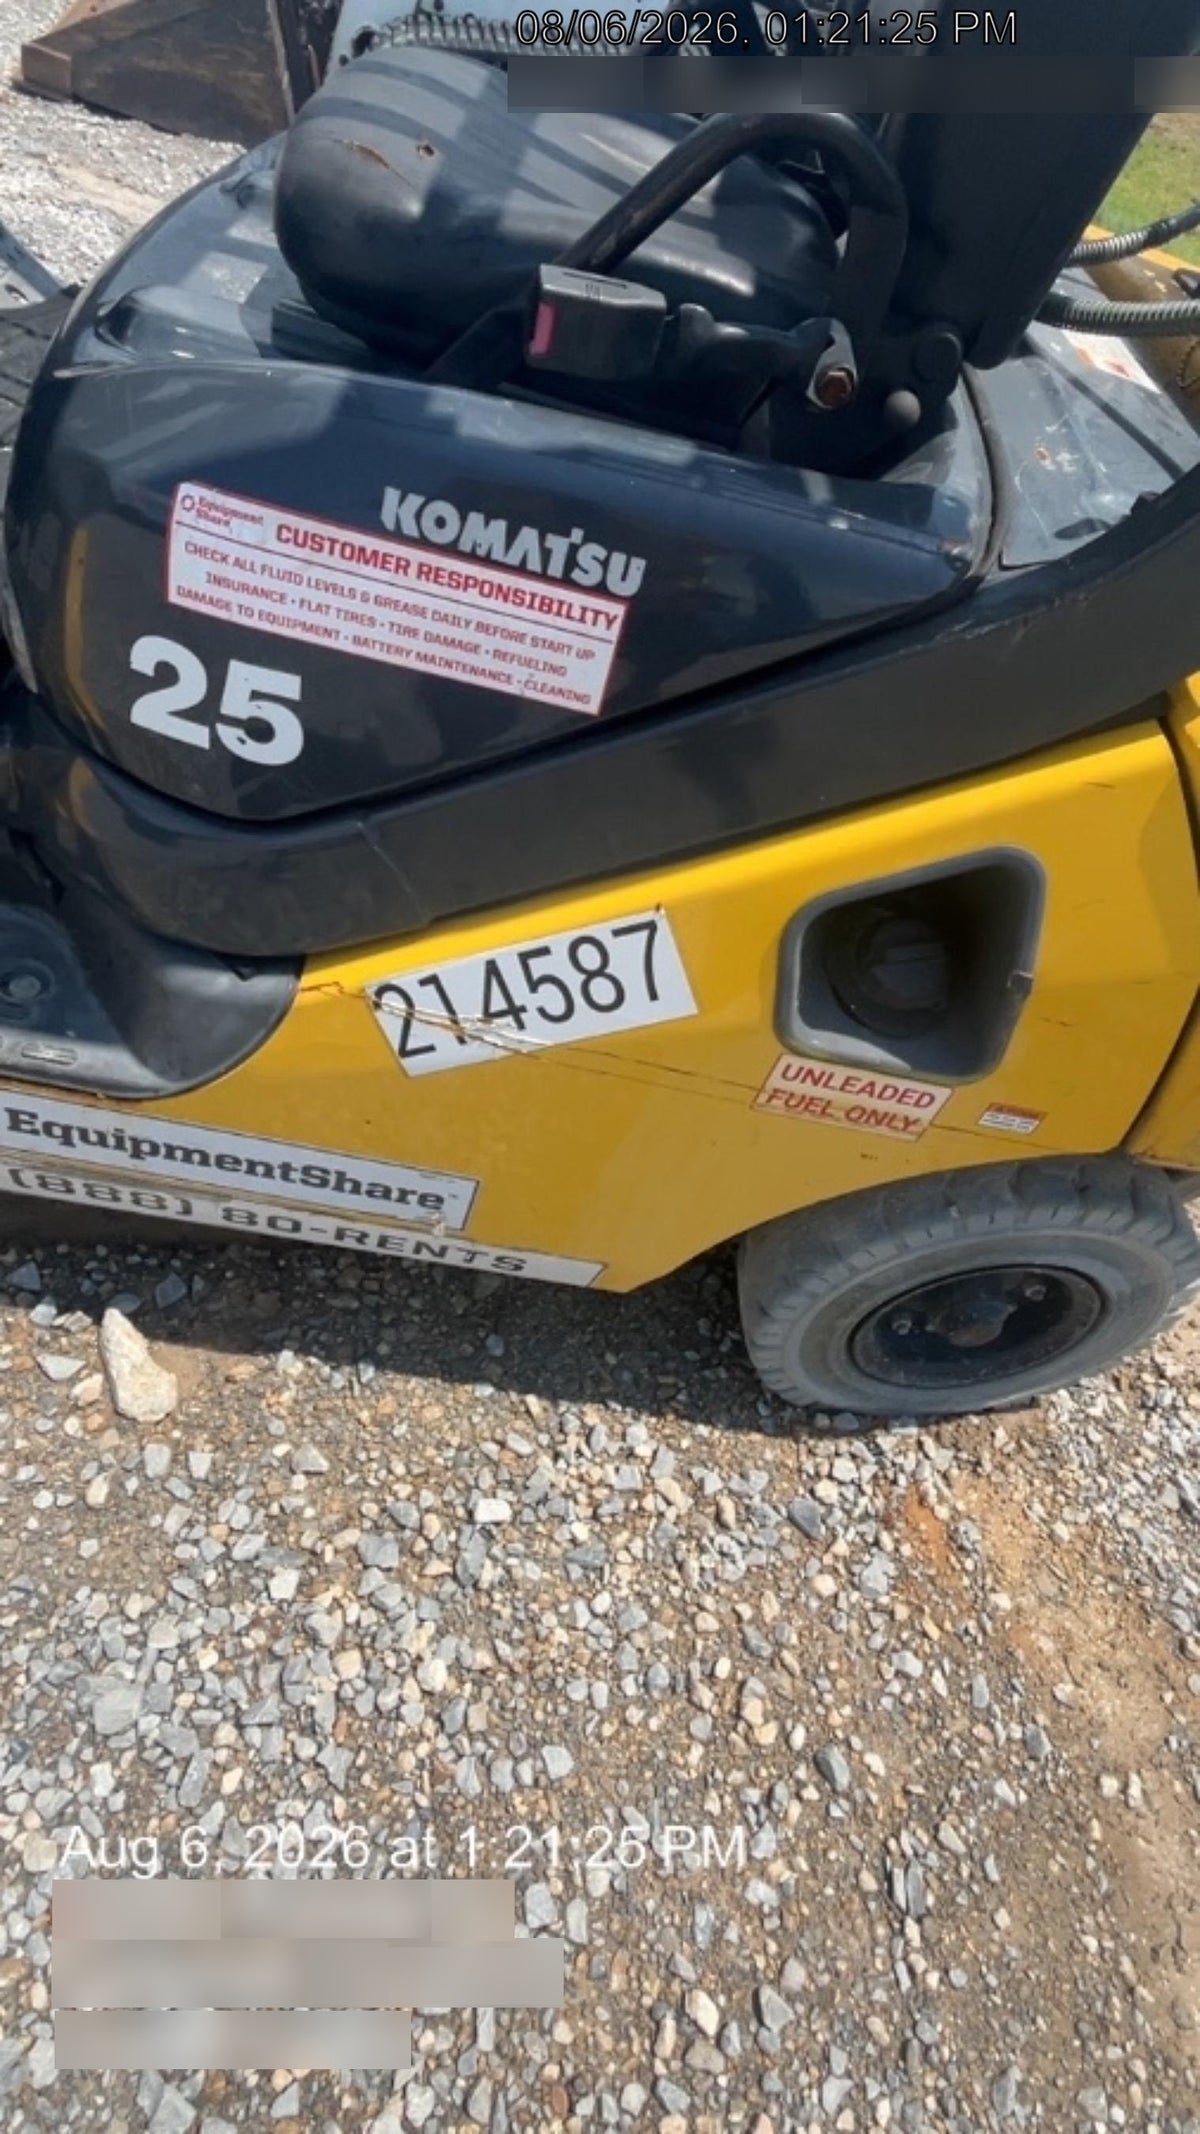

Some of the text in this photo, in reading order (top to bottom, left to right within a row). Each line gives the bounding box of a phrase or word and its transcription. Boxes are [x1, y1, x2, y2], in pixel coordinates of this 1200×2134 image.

[277, 524, 618, 631] CUSTOMER RESPONSIBILITY
[380, 486, 647, 598] KOMATSU
[177, 585, 591, 706] DAMAGE TO EQUIPMENT BATTERY MAINTENANCE CLEANING
[185, 540, 229, 564] CHECK
[232, 556, 257, 575] ALL
[261, 564, 303, 586] FLUID
[307, 576, 356, 601] LEVELS
[374, 594, 427, 620] GREASE
[431, 609, 472, 630] DAILY
[474, 621, 527, 646] BEFORE
[531, 635, 573, 657] START
[575, 647, 596, 661] UP
[205, 571, 567, 677] INSURANCE FLAT TIRES TIRE DAMAGE REFUELING
[130, 635, 304, 766] 25
[374, 919, 659, 1059] 214587
[766, 1088, 921, 1133] FUEL ONLY
[781, 1063, 935, 1109] UNLEADED
[4, 1107, 444, 1211] EquipmentShare
[8, 1168, 528, 1272] (888) 80-RENTS
